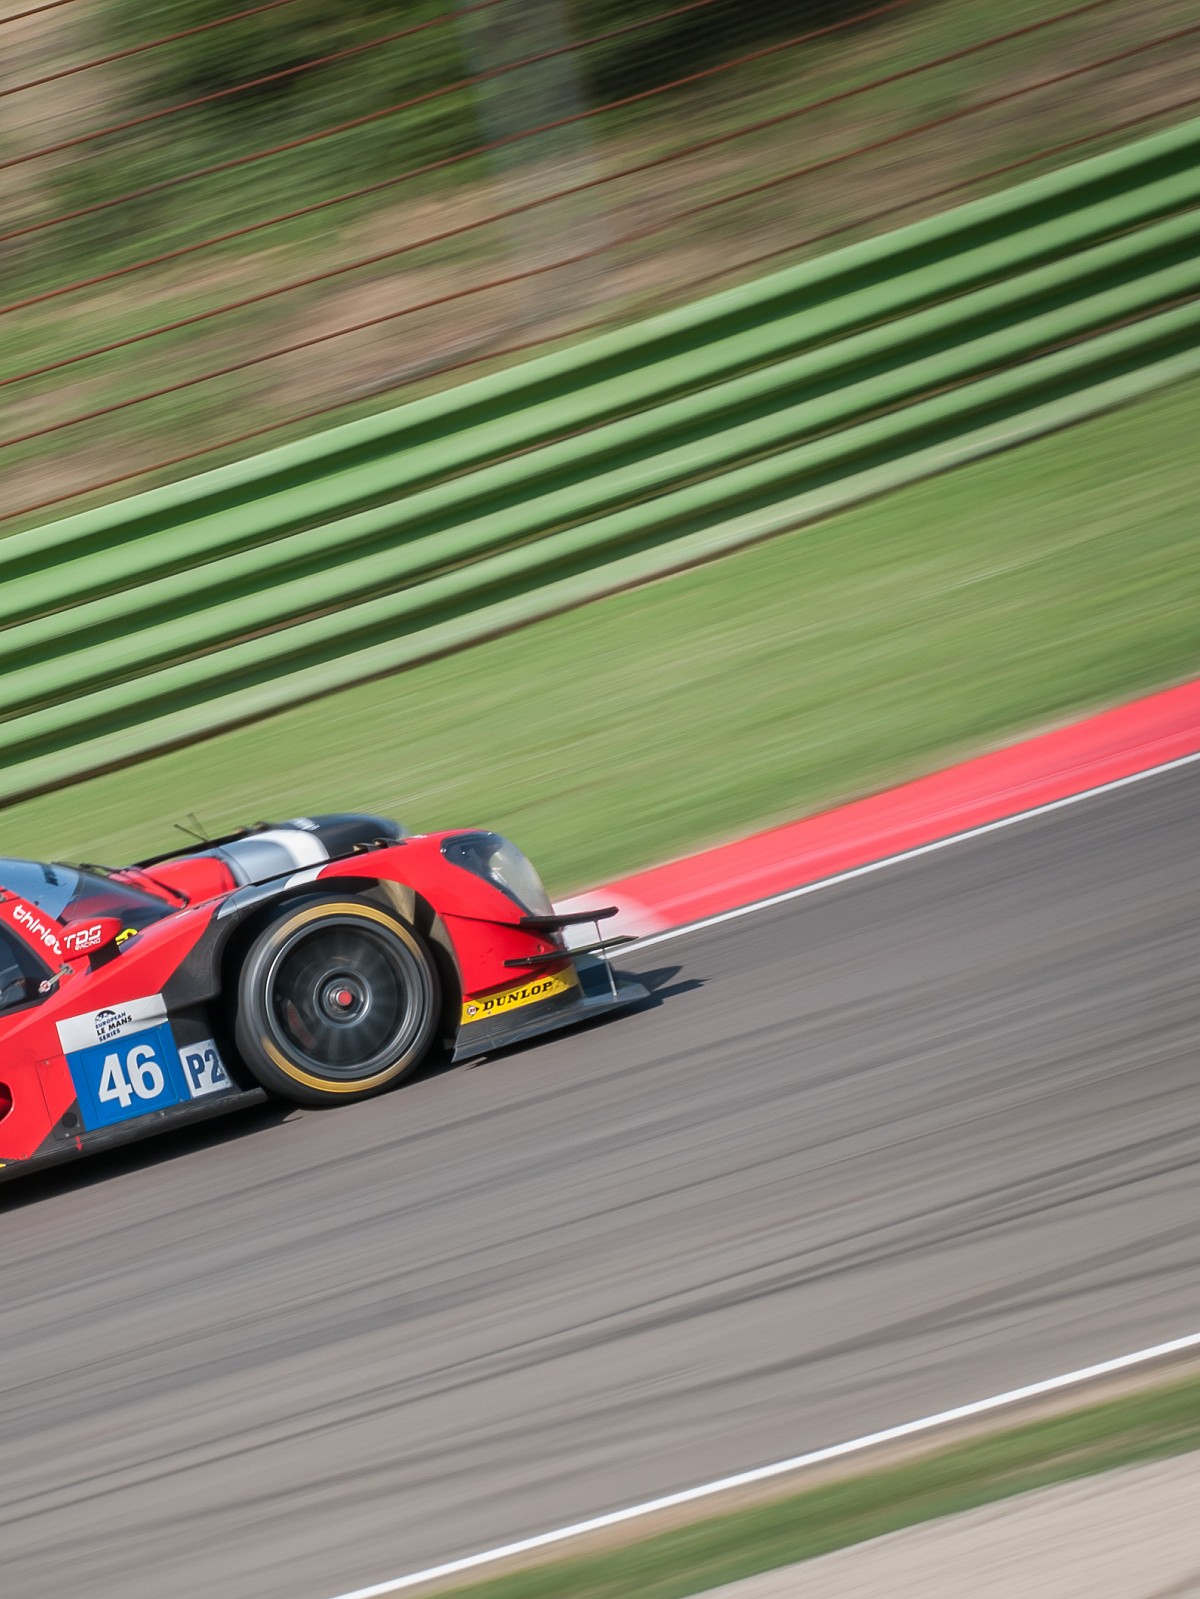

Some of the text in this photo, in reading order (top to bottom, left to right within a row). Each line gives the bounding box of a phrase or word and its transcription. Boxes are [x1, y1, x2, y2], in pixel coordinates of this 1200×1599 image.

[64, 925, 102, 949] TDS
[482, 980, 554, 1012] DUNLOP
[95, 1011, 126, 1030] EUROPEAN
[97, 1015, 132, 1036] LE MANS
[98, 1028, 121, 1042] SERIES
[98, 1044, 165, 1108] 46
[186, 1048, 225, 1090] P2
